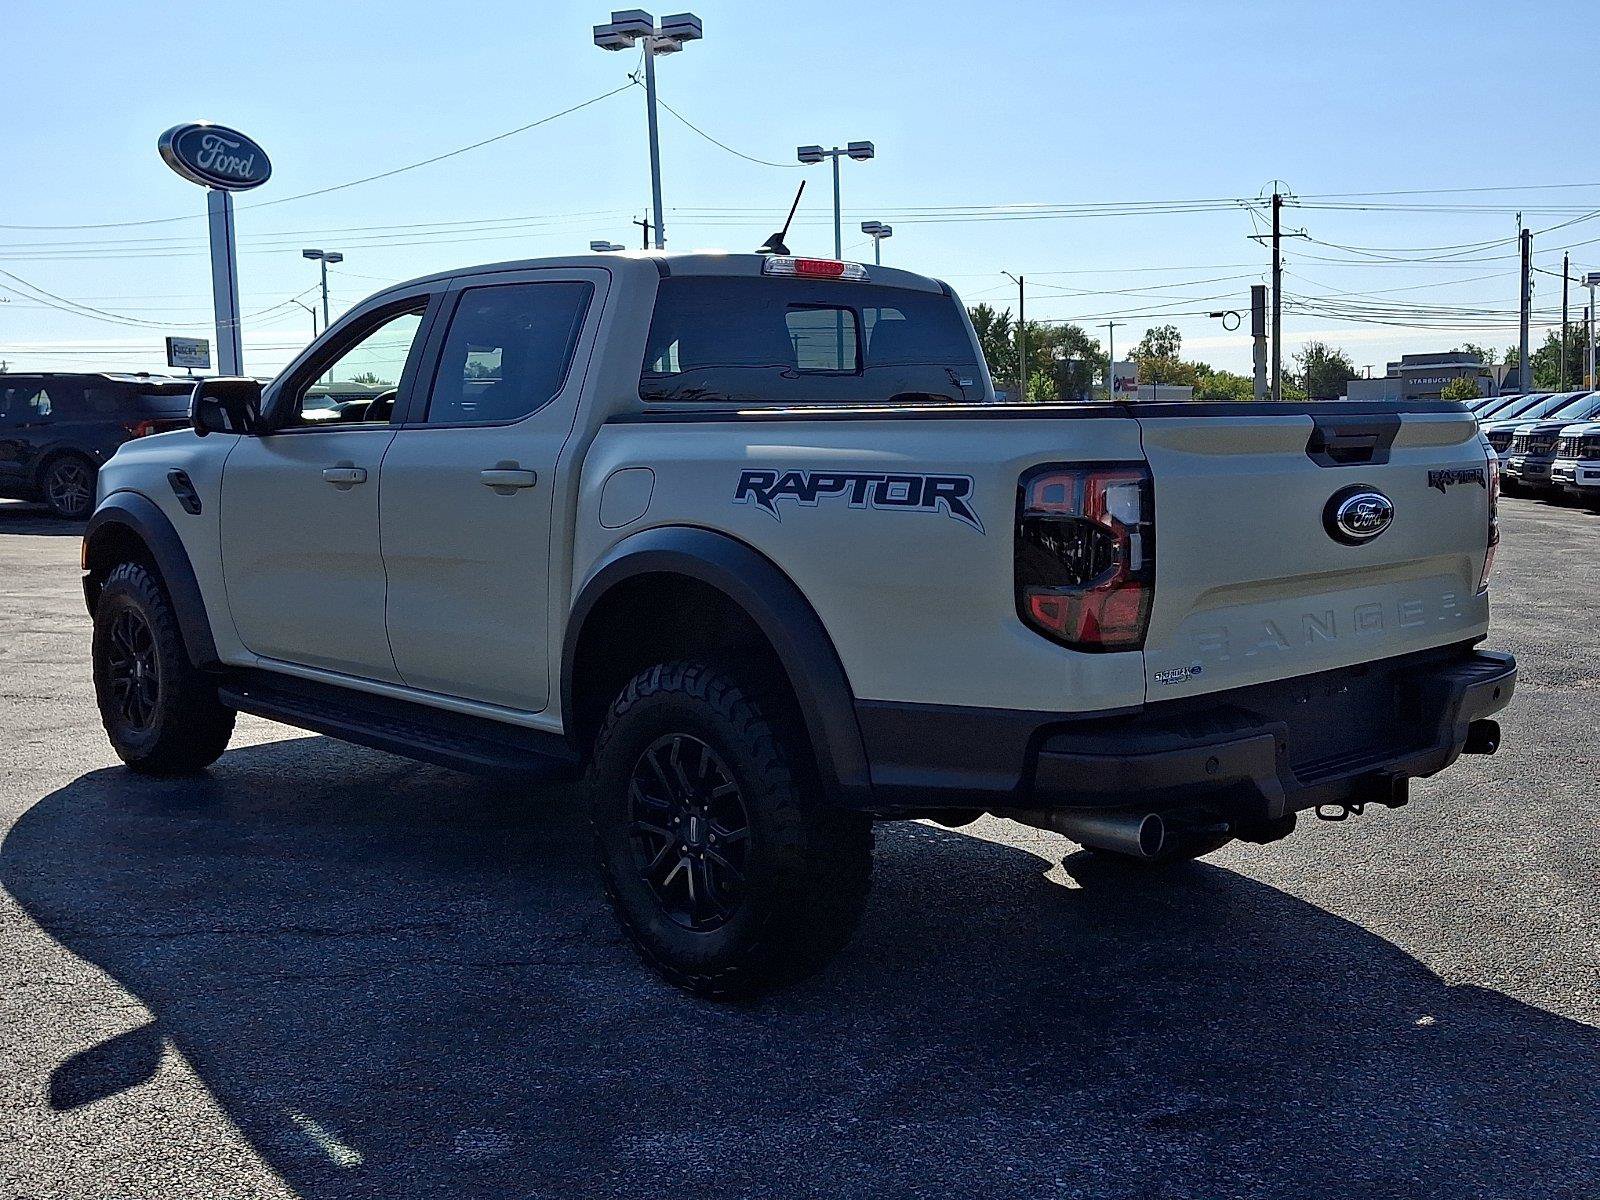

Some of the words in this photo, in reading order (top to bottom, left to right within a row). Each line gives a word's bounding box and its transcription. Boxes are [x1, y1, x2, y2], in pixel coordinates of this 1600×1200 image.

[197, 134, 254, 178] Ford
[1409, 377, 1451, 385] STARBUCKS
[733, 469, 986, 535] RAPTOR
[1353, 502, 1383, 527] Ford
